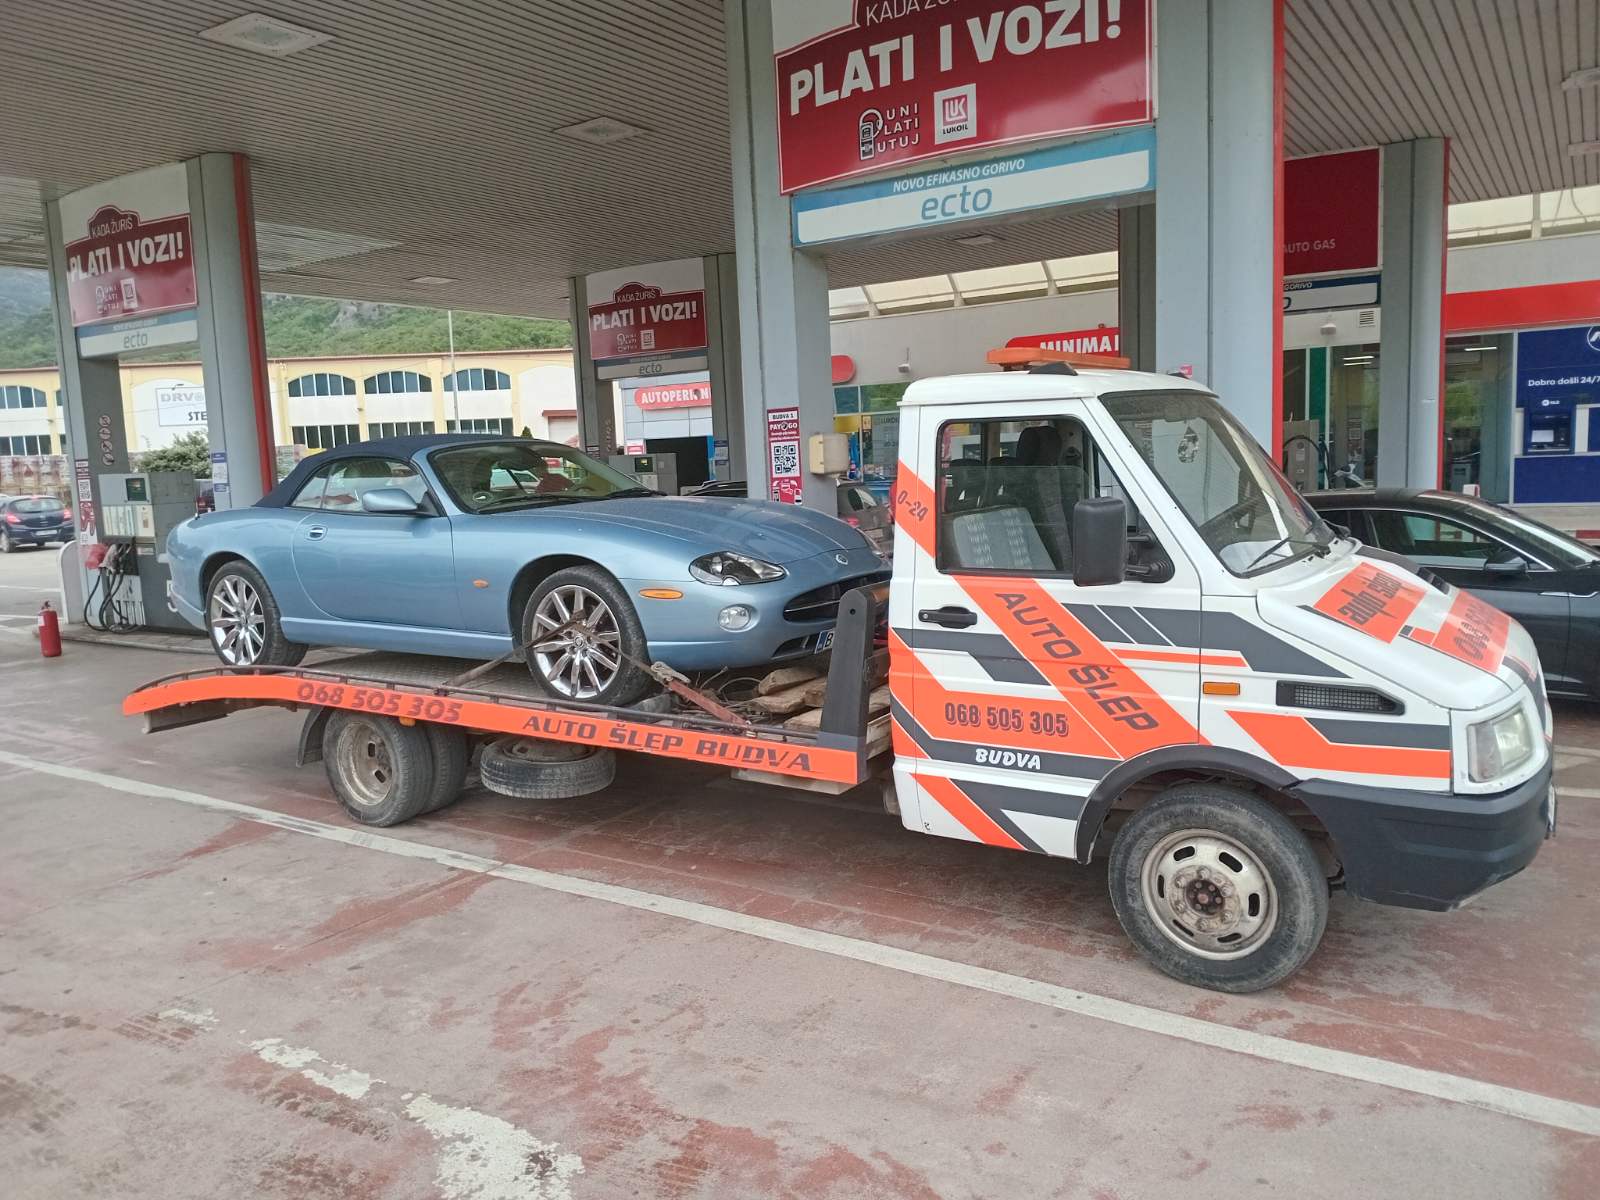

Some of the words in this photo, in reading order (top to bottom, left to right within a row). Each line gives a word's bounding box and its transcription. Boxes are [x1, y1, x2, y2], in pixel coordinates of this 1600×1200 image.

[866, 0, 920, 26] KADA
[790, 35, 914, 116] PLATI
[939, 24, 953, 73] I
[966, 0, 1121, 63] VOZI!
[942, 124, 968, 135] LUKOIL
[877, 134, 919, 153] UTUJ
[893, 178, 924, 193] NOVO
[926, 167, 980, 187] EFIKASNO
[982, 158, 1025, 176] GORIVO
[921, 185, 993, 221] ecto
[91, 224, 111, 238] KADA
[69, 246, 113, 283] PLATI
[118, 243, 126, 272] I
[127, 232, 184, 267] VOZI!
[1313, 239, 1336, 250] GAS
[592, 309, 634, 332] PLATI
[641, 306, 647, 325] I
[650, 301, 698, 323] VOZI!
[123, 332, 148, 349] ecto
[1040, 334, 1119, 354] MINIMA
[639, 362, 662, 376] ecto
[1528, 378, 1556, 387] Dobro
[1557, 376, 1579, 386] došli
[1580, 375, 1600, 385] 24/7
[995, 592, 1082, 659] AUTO
[1068, 665, 1159, 731] ŠLEP
[297, 682, 345, 705] 068
[351, 689, 402, 714] 505
[407, 697, 463, 722] 305
[944, 702, 982, 727] 068
[986, 708, 1024, 732] 505
[1030, 711, 1069, 737] 305
[522, 715, 596, 739] AUTO
[608, 722, 683, 751] ŠLEP
[696, 738, 813, 772] BUDVA
[975, 748, 1041, 770] BUDVA
